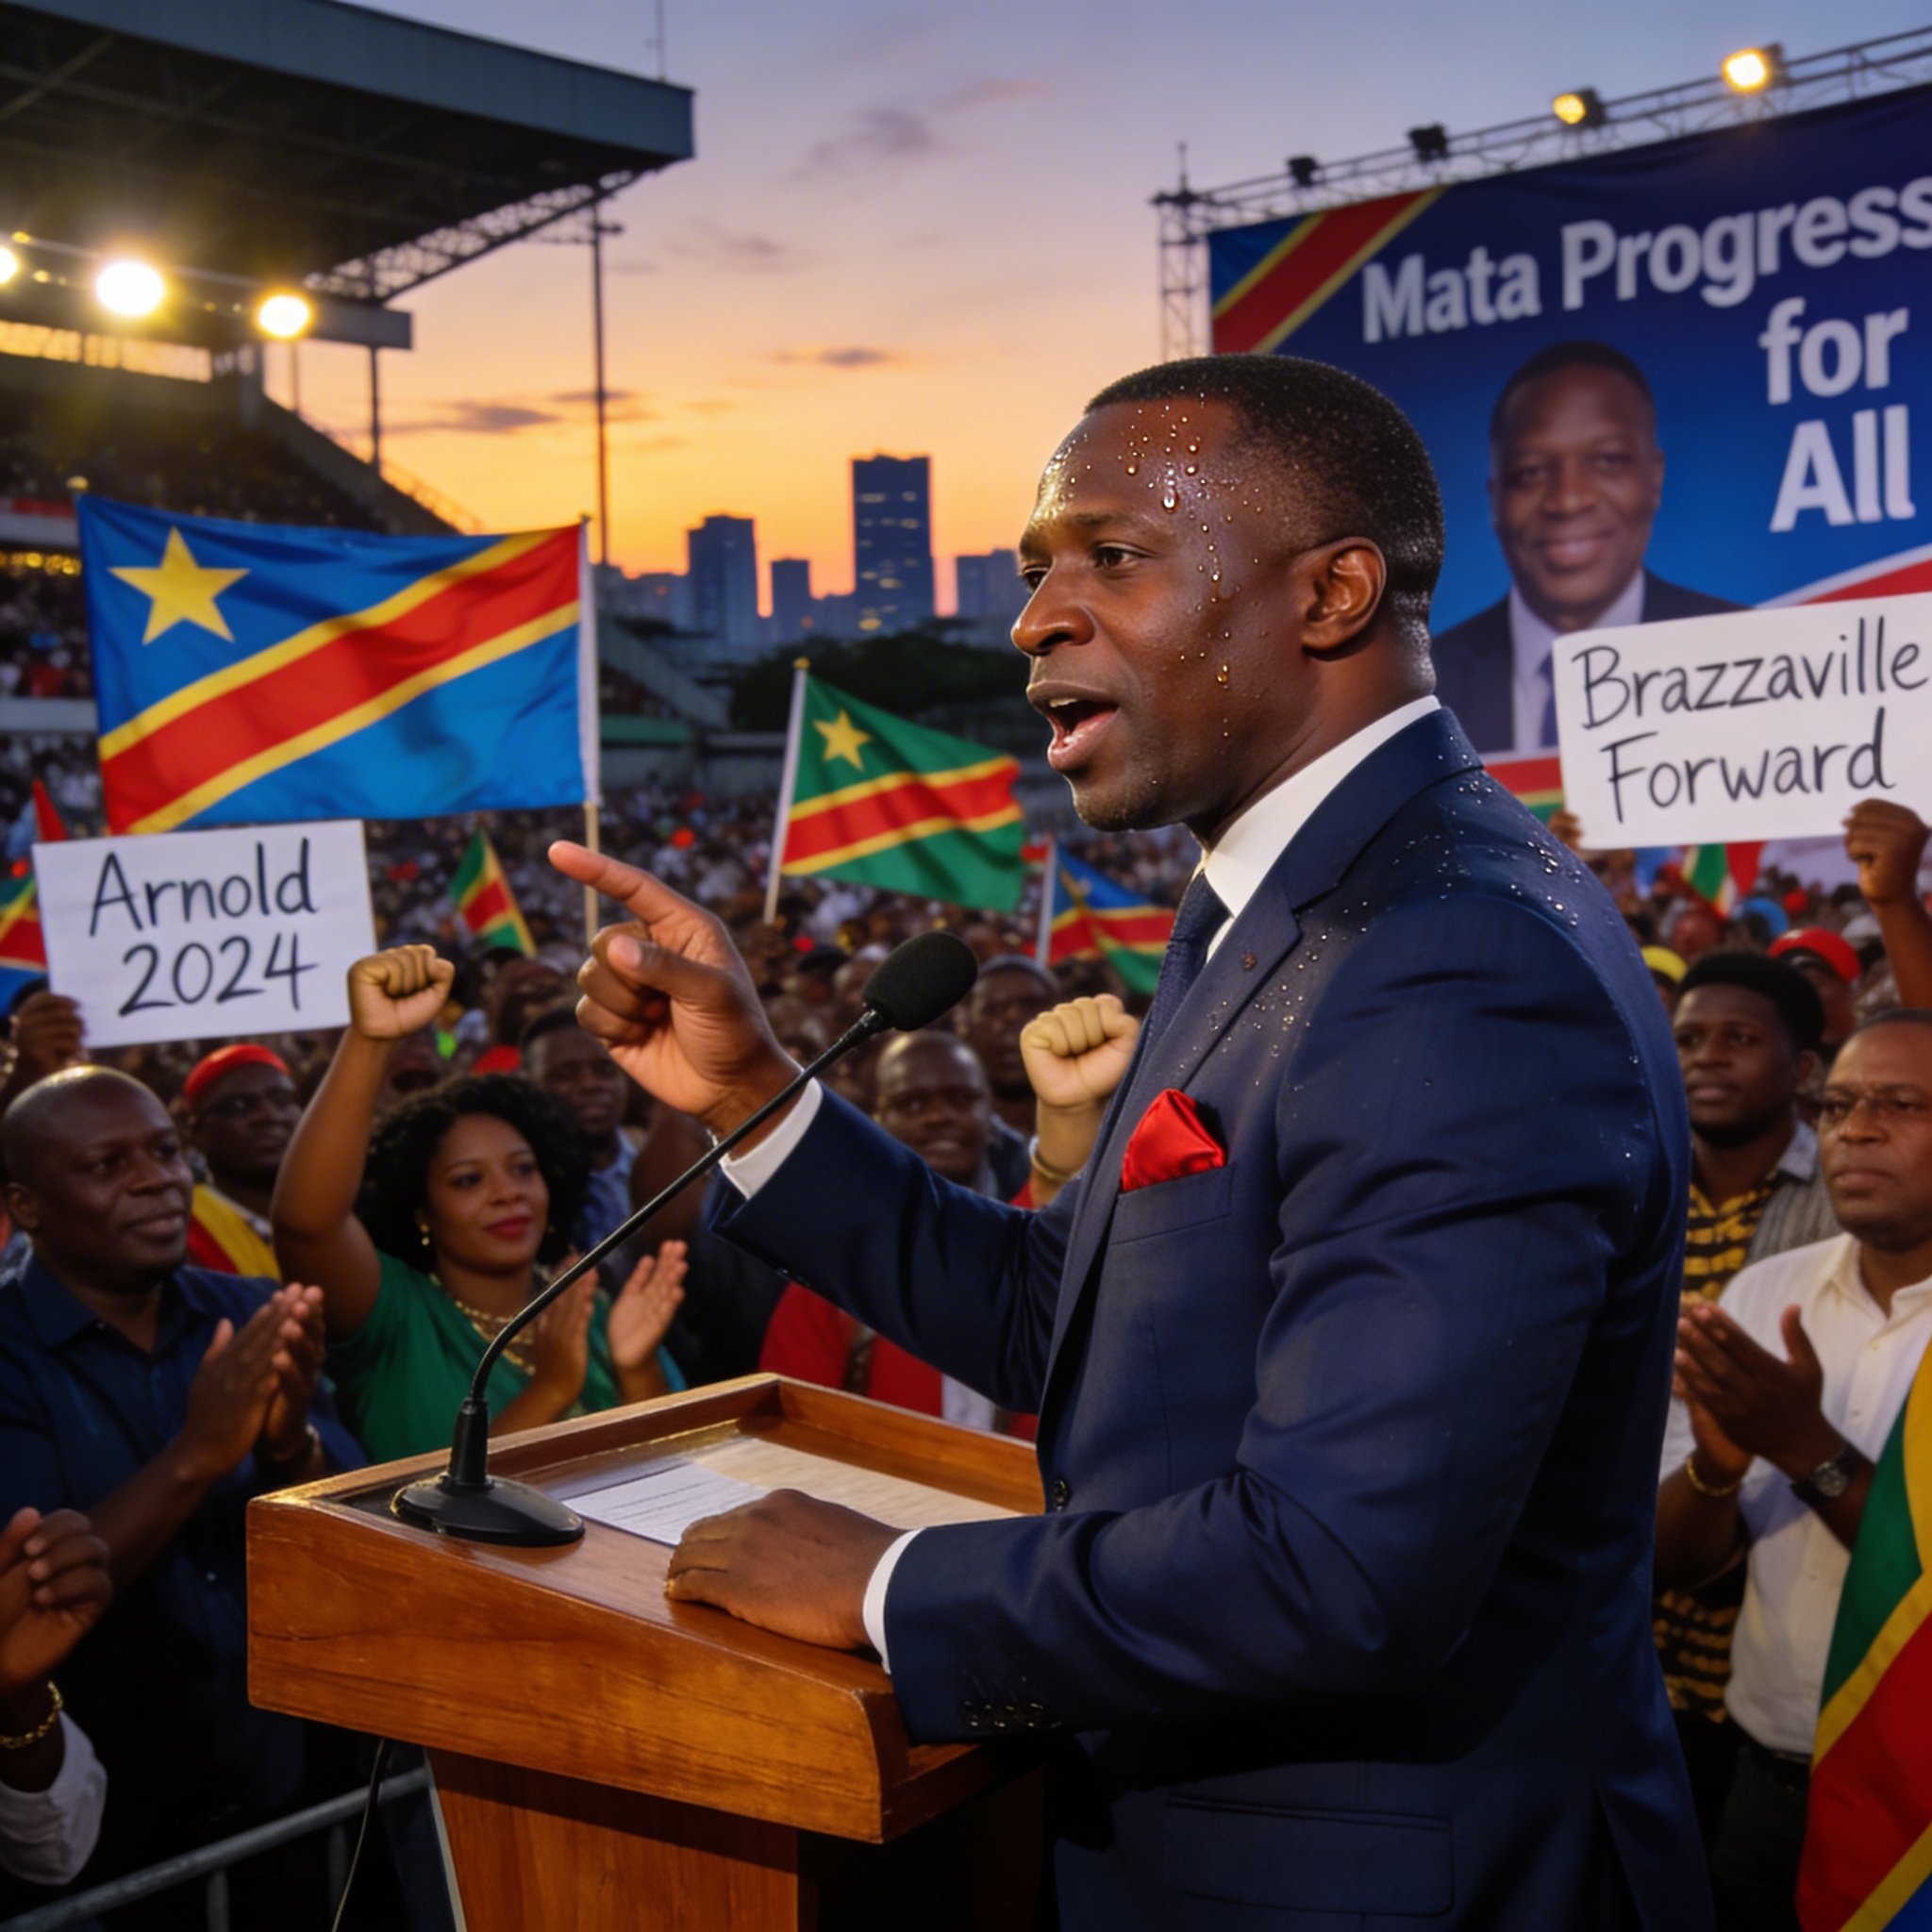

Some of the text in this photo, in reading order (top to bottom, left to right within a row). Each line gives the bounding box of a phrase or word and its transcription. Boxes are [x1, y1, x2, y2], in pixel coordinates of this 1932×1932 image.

[1362, 176, 1932, 343] Mata Progress
[1758, 297, 1908, 406] for
[1769, 404, 1916, 533] All
[1571, 615, 1929, 730] Brazzaville
[1600, 706, 1897, 824] Forward
[90, 837, 319, 938] Arnold
[118, 933, 319, 1018] 2024
